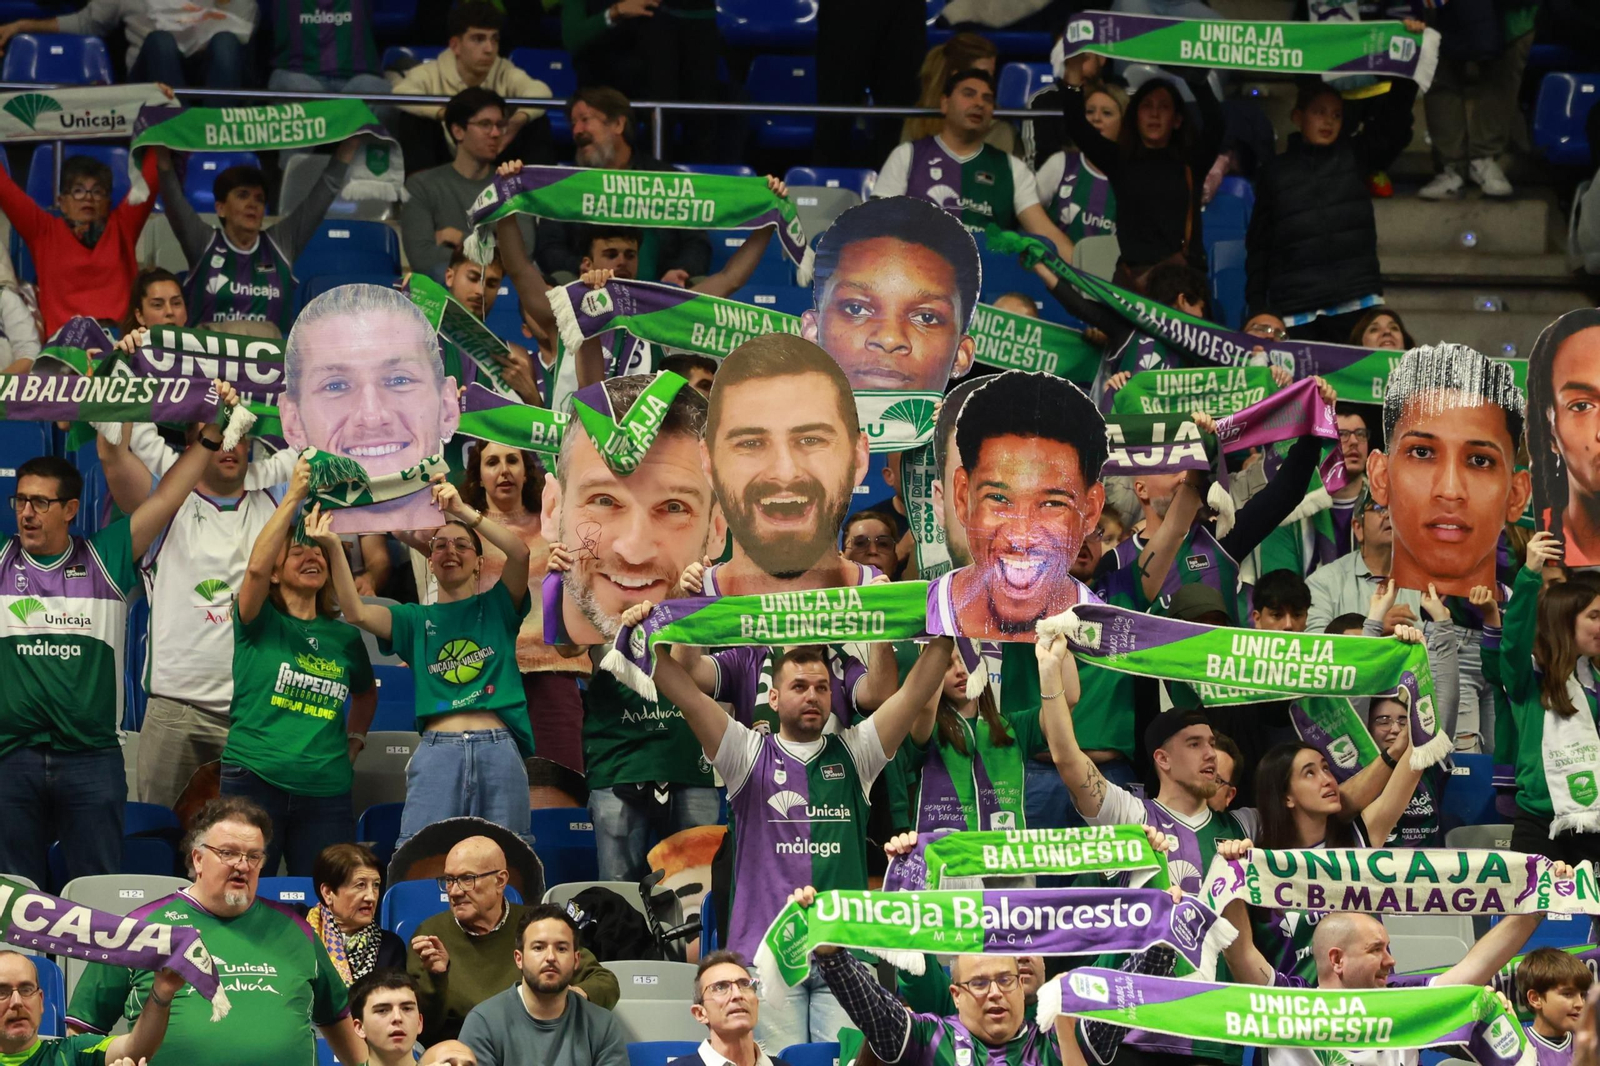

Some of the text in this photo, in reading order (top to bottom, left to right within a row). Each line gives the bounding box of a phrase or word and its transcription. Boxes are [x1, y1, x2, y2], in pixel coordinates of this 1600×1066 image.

[1200, 24, 1284, 46] UNICAJA
[1180, 40, 1303, 68] BALONCESTO
[60, 110, 126, 130] Unicaja
[222, 104, 306, 124] UNICAJA
[205, 118, 326, 146] BALONCESTO
[602, 174, 695, 198] UNICAJA
[582, 193, 715, 222] BALONCESTO
[230, 281, 280, 300] Unicaja
[691, 323, 757, 353] BALO
[141, 330, 286, 384] UNIC
[1157, 368, 1247, 395] UNICAJA
[760, 588, 863, 613] UNICAJA
[45, 612, 92, 627] Unicaja
[740, 611, 885, 639] BALONCESTO
[428, 646, 495, 675] UNICAJA VALENCIA
[1232, 634, 1335, 664] UNICAJA
[1206, 653, 1357, 691] BALONCESTO
[270, 695, 303, 712] UNICAJA
[284, 685, 329, 705] BELGRADO
[621, 704, 685, 724] Andalucía
[805, 803, 851, 820] Unicaja
[983, 840, 1143, 869] BALONCESTO
[1265, 849, 1511, 884] UNICAJA
[126, 890, 138, 898] 12
[816, 890, 943, 935] Unicaja
[953, 896, 1152, 931] Baloncesto
[224, 962, 277, 975] Unicaja
[1250, 993, 1367, 1016] UNICAJA
[1226, 1011, 1393, 1043] BALONCESTO
